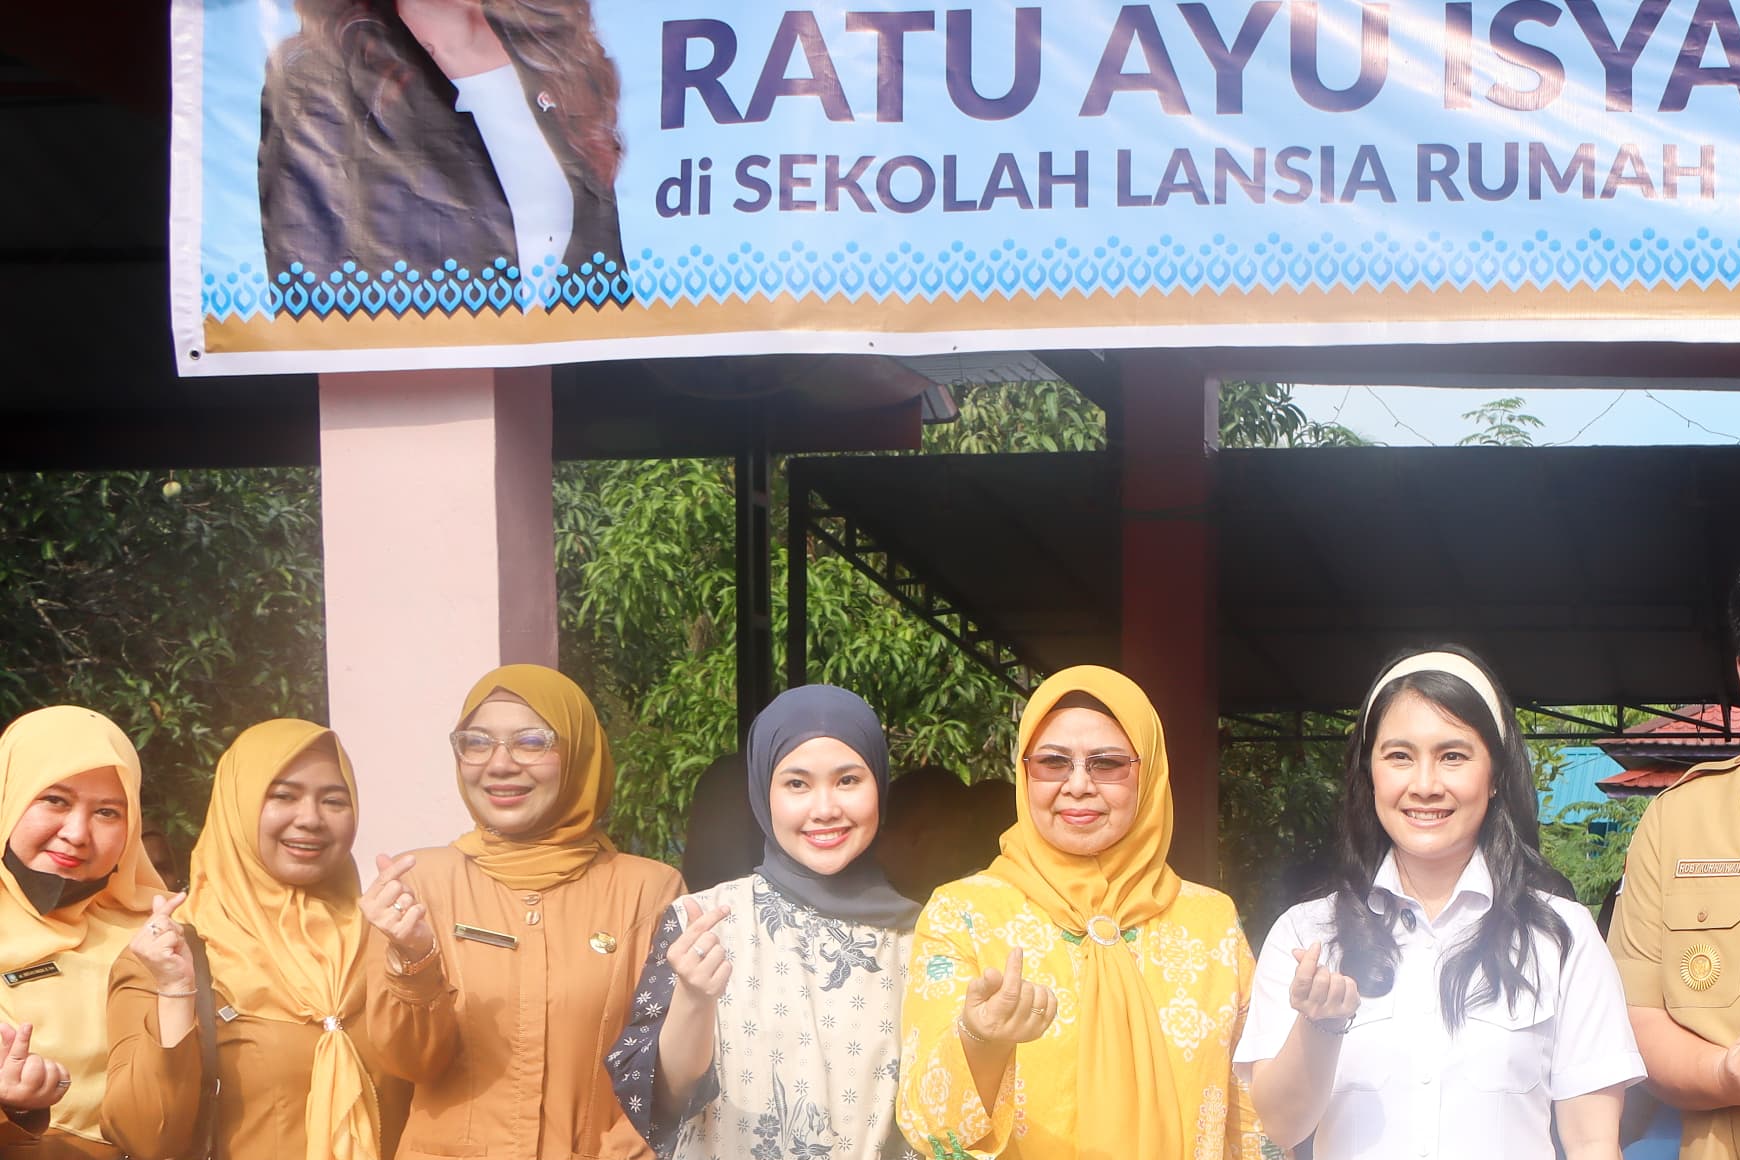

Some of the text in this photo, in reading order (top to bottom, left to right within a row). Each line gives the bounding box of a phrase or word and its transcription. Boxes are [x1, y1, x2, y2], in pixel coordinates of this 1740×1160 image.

[660, 7, 1043, 131] RATU
[1078, 0, 1388, 116] AYU
[655, 157, 712, 219] di
[733, 149, 1090, 214] SEKOLAH
[1116, 143, 1396, 208] LANSIA
[1416, 142, 1716, 203] RUMAH
